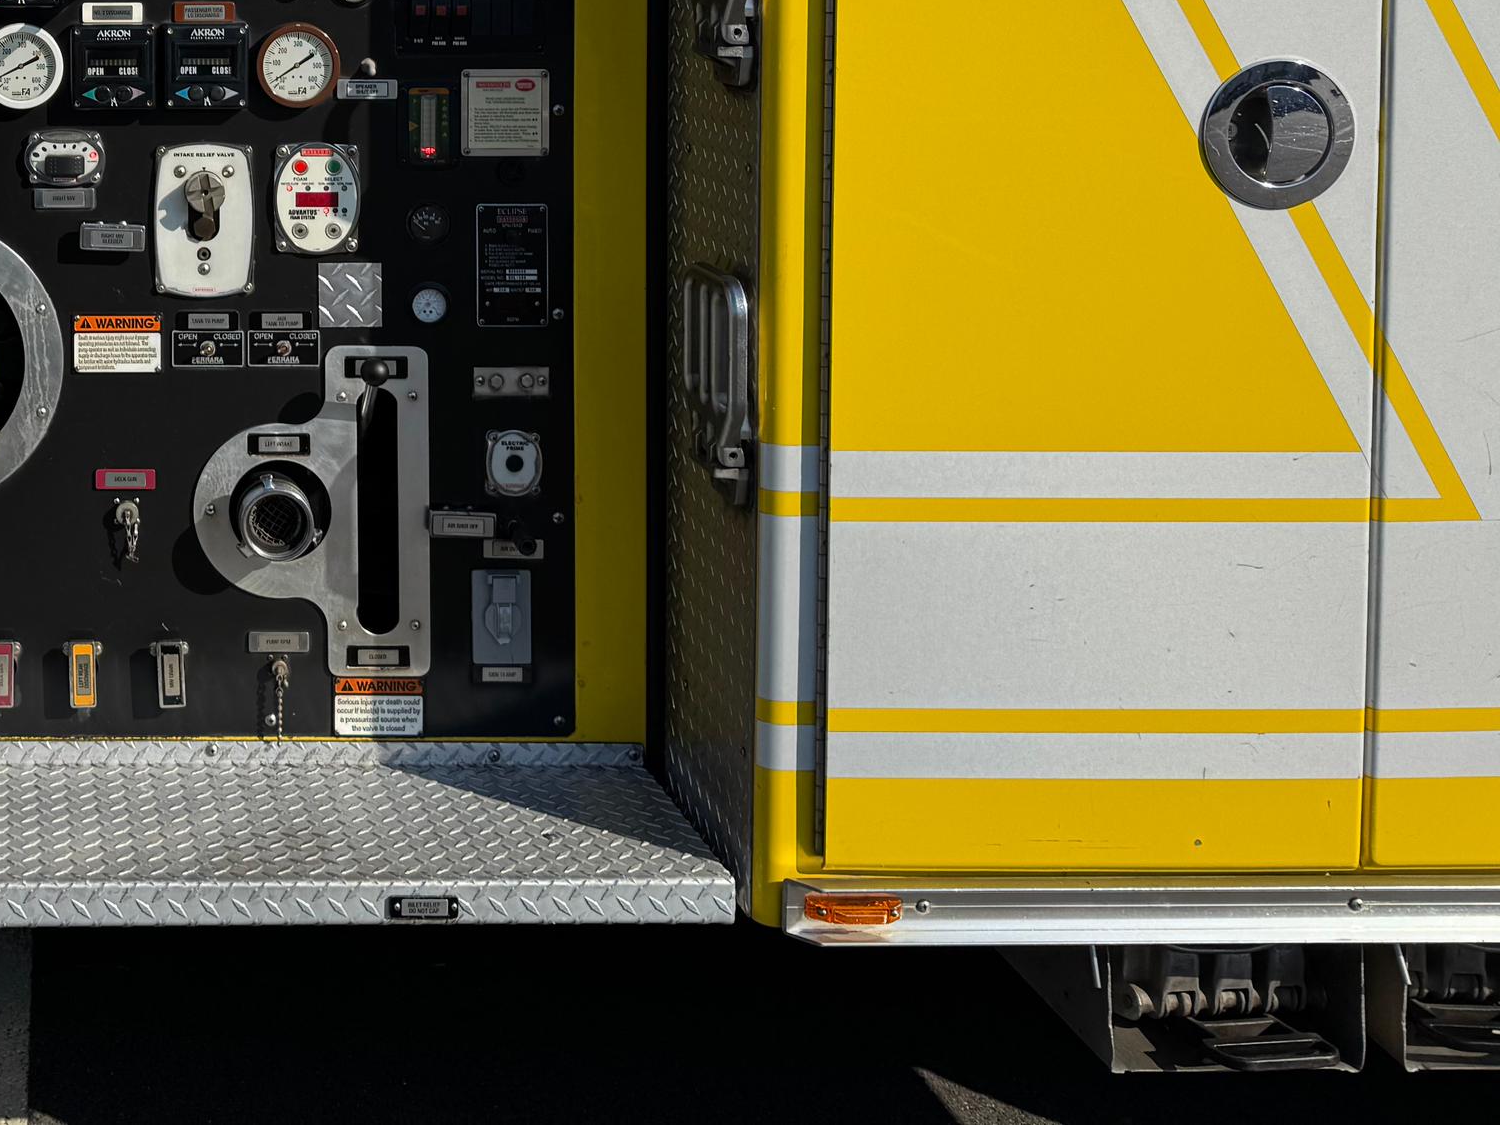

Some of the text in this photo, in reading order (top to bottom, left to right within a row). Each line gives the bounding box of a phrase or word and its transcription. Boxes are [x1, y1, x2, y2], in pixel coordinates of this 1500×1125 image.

[97, 29, 131, 37] AKRON
[190, 28, 225, 36] AKRON
[87, 67, 104, 75] OPEN
[180, 66, 197, 75] OPEN
[95, 318, 155, 329] WARNING
[356, 681, 417, 691] WARNING
[360, 698, 376, 707] injury
[387, 707, 412, 715] supplied
[413, 707, 420, 715] by
[345, 716, 379, 724] pressurized
